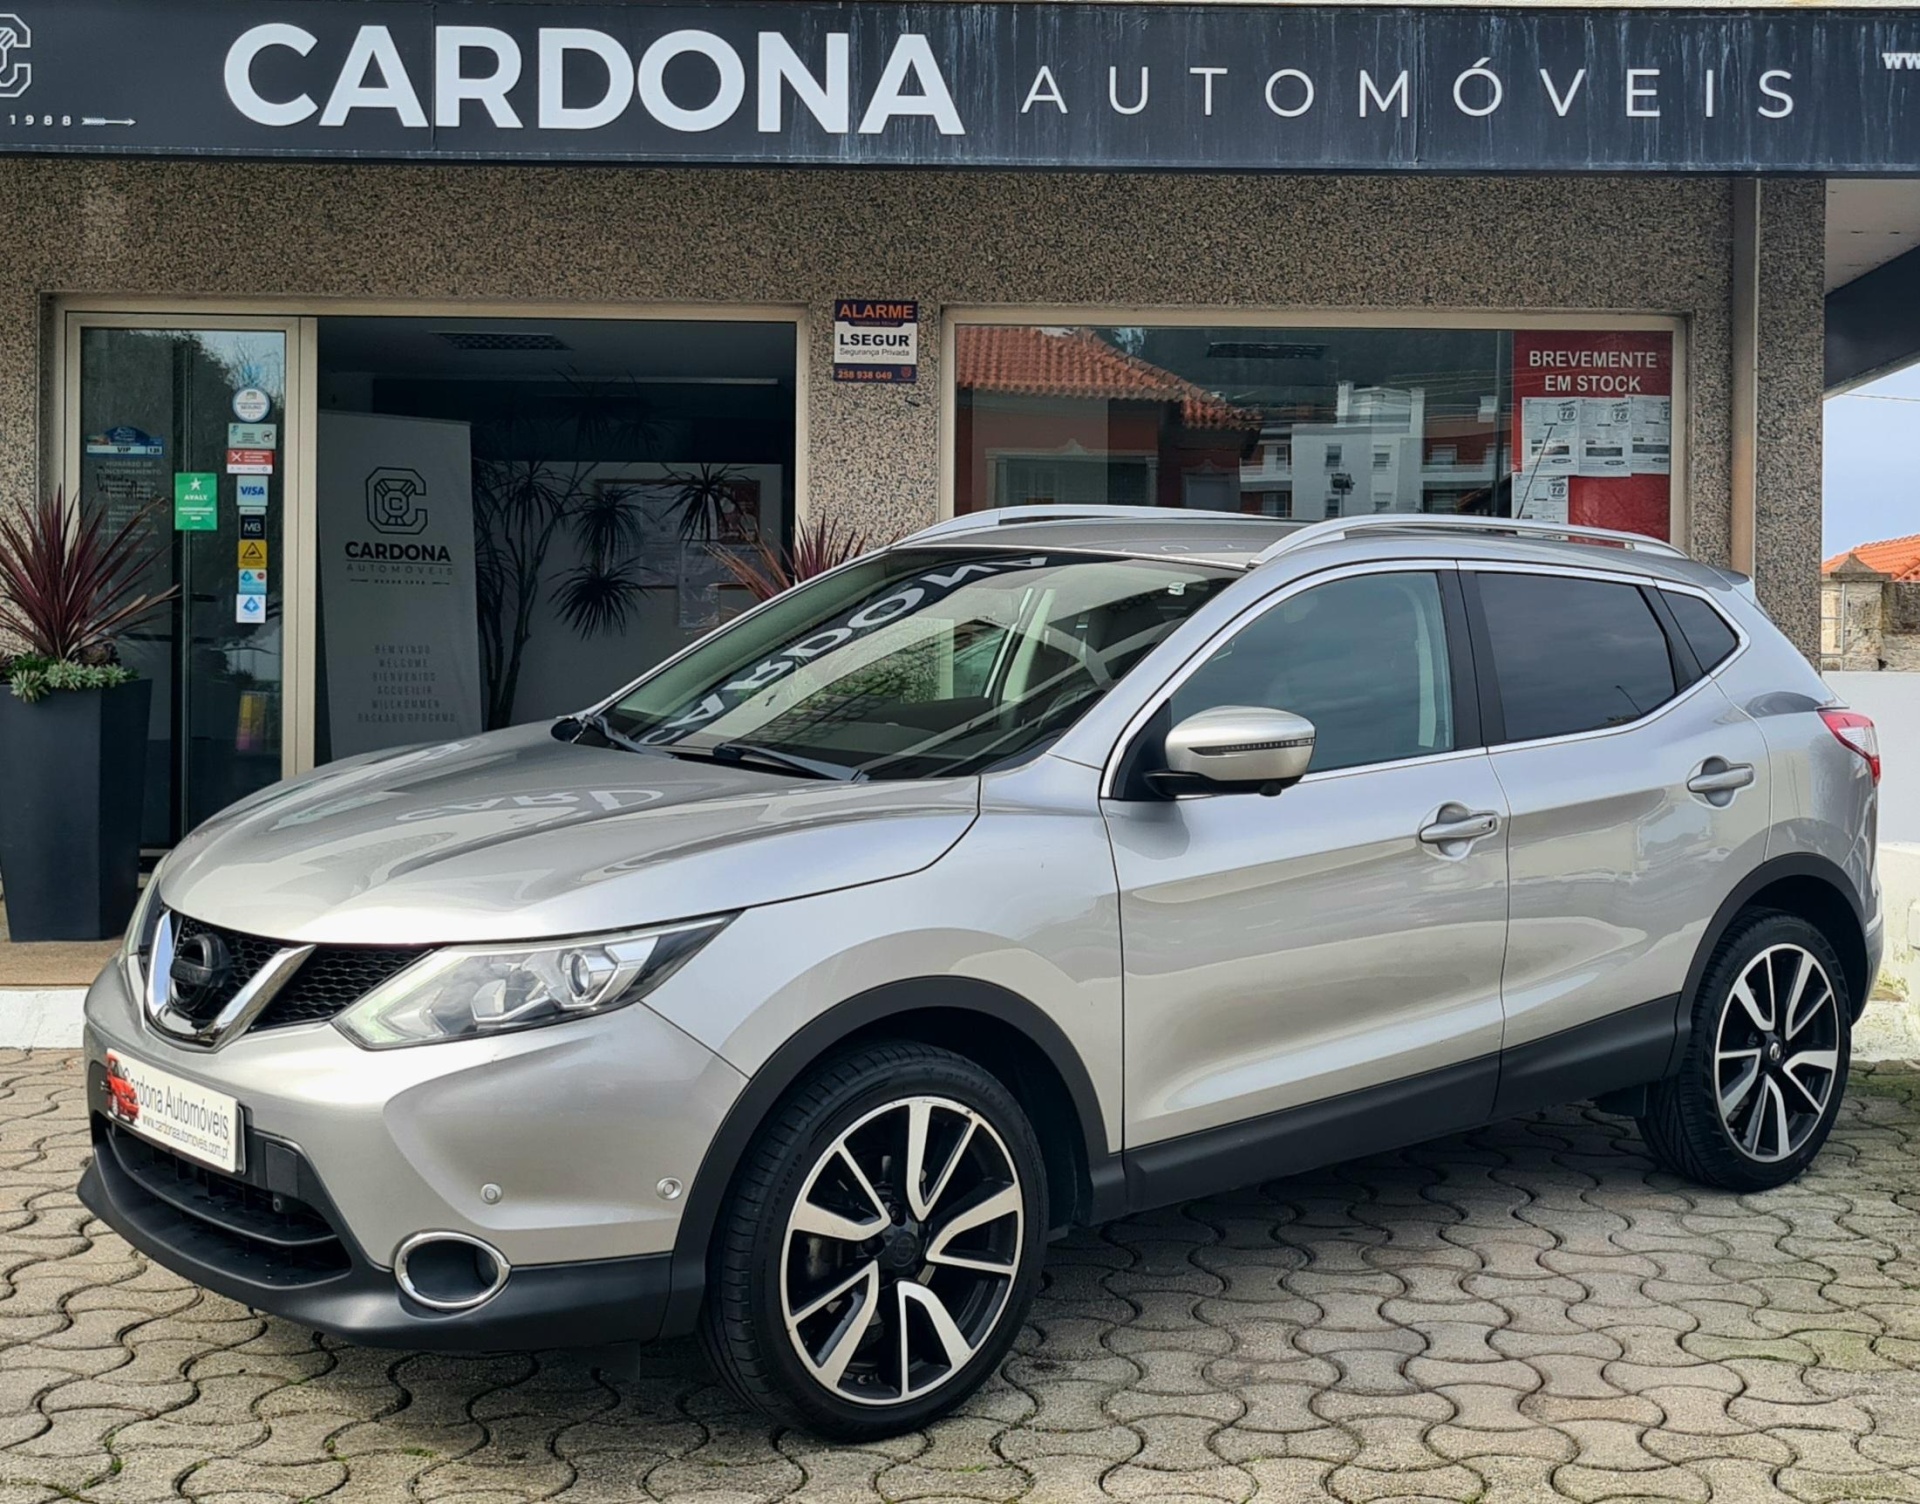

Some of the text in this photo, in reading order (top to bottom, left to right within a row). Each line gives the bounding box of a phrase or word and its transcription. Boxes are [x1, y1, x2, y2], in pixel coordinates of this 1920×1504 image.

[224, 22, 1794, 134] CARDONA AUTOMÓVEIS
[9, 114, 72, 126] 1988
[839, 303, 914, 319] ALARME
[839, 333, 910, 347] LSEGUR
[839, 348, 909, 357] Segurança Privada
[1529, 351, 1657, 368] BREVEMENTE
[1544, 375, 1641, 392] EM STOCK
[240, 486, 265, 496] VISA
[243, 522, 262, 533] MB
[345, 541, 452, 562] CARDONA
[164, 1085, 229, 1140] Automóveis
